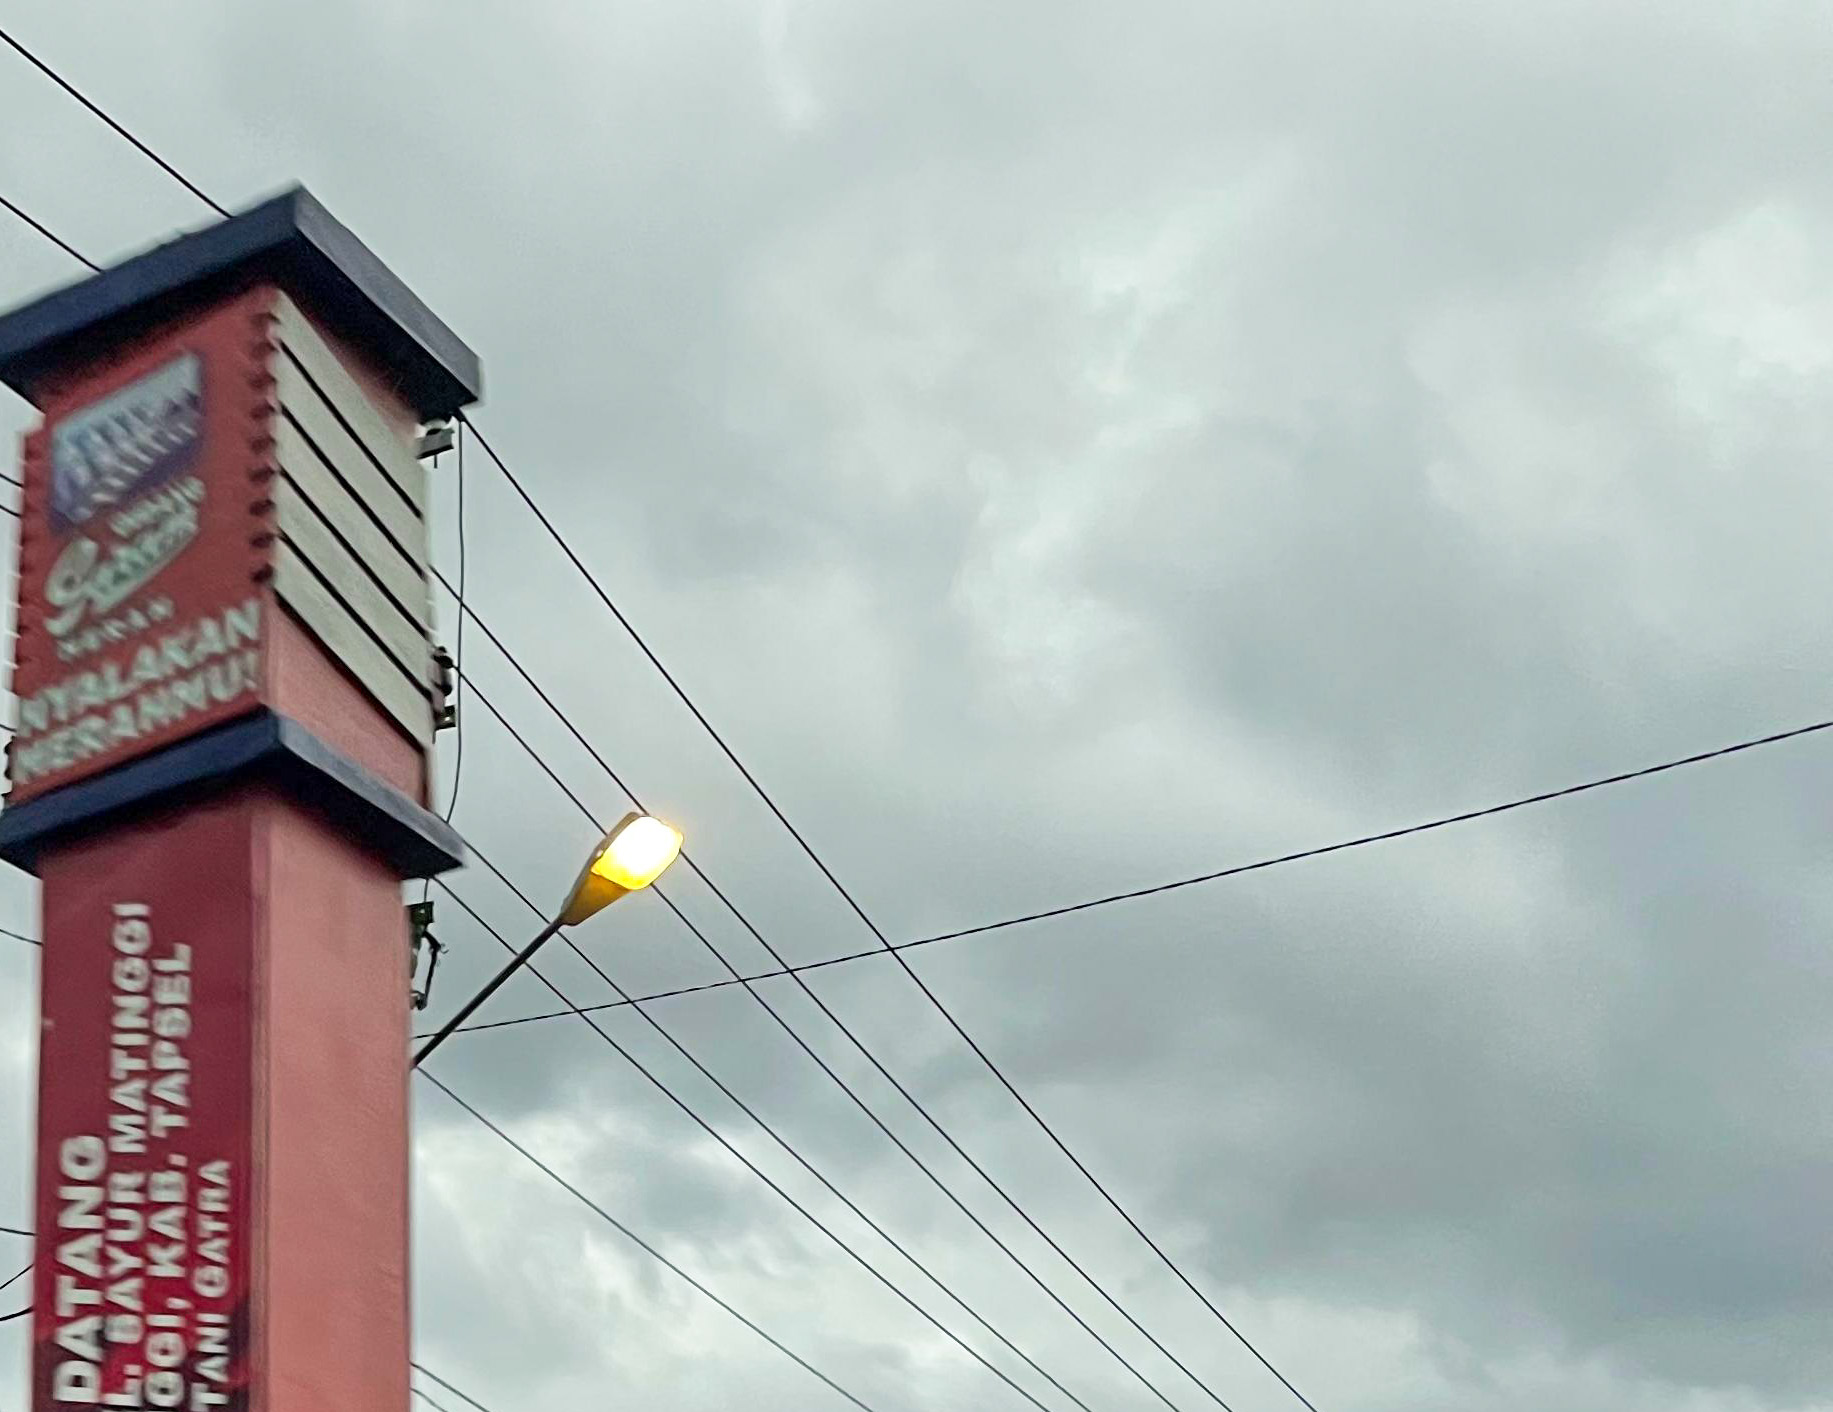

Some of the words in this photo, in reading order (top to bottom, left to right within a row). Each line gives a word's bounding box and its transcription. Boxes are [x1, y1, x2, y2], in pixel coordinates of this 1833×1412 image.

[108, 903, 151, 1155] MATINGGI
[151, 943, 192, 1138] TAPSEL
[53, 1135, 106, 1402] DATANG
[104, 1171, 145, 1343] SAYUR
[148, 1154, 188, 1278] KAB.
[192, 1160, 232, 1298] GATRA
[190, 1312, 230, 1412] TANI
